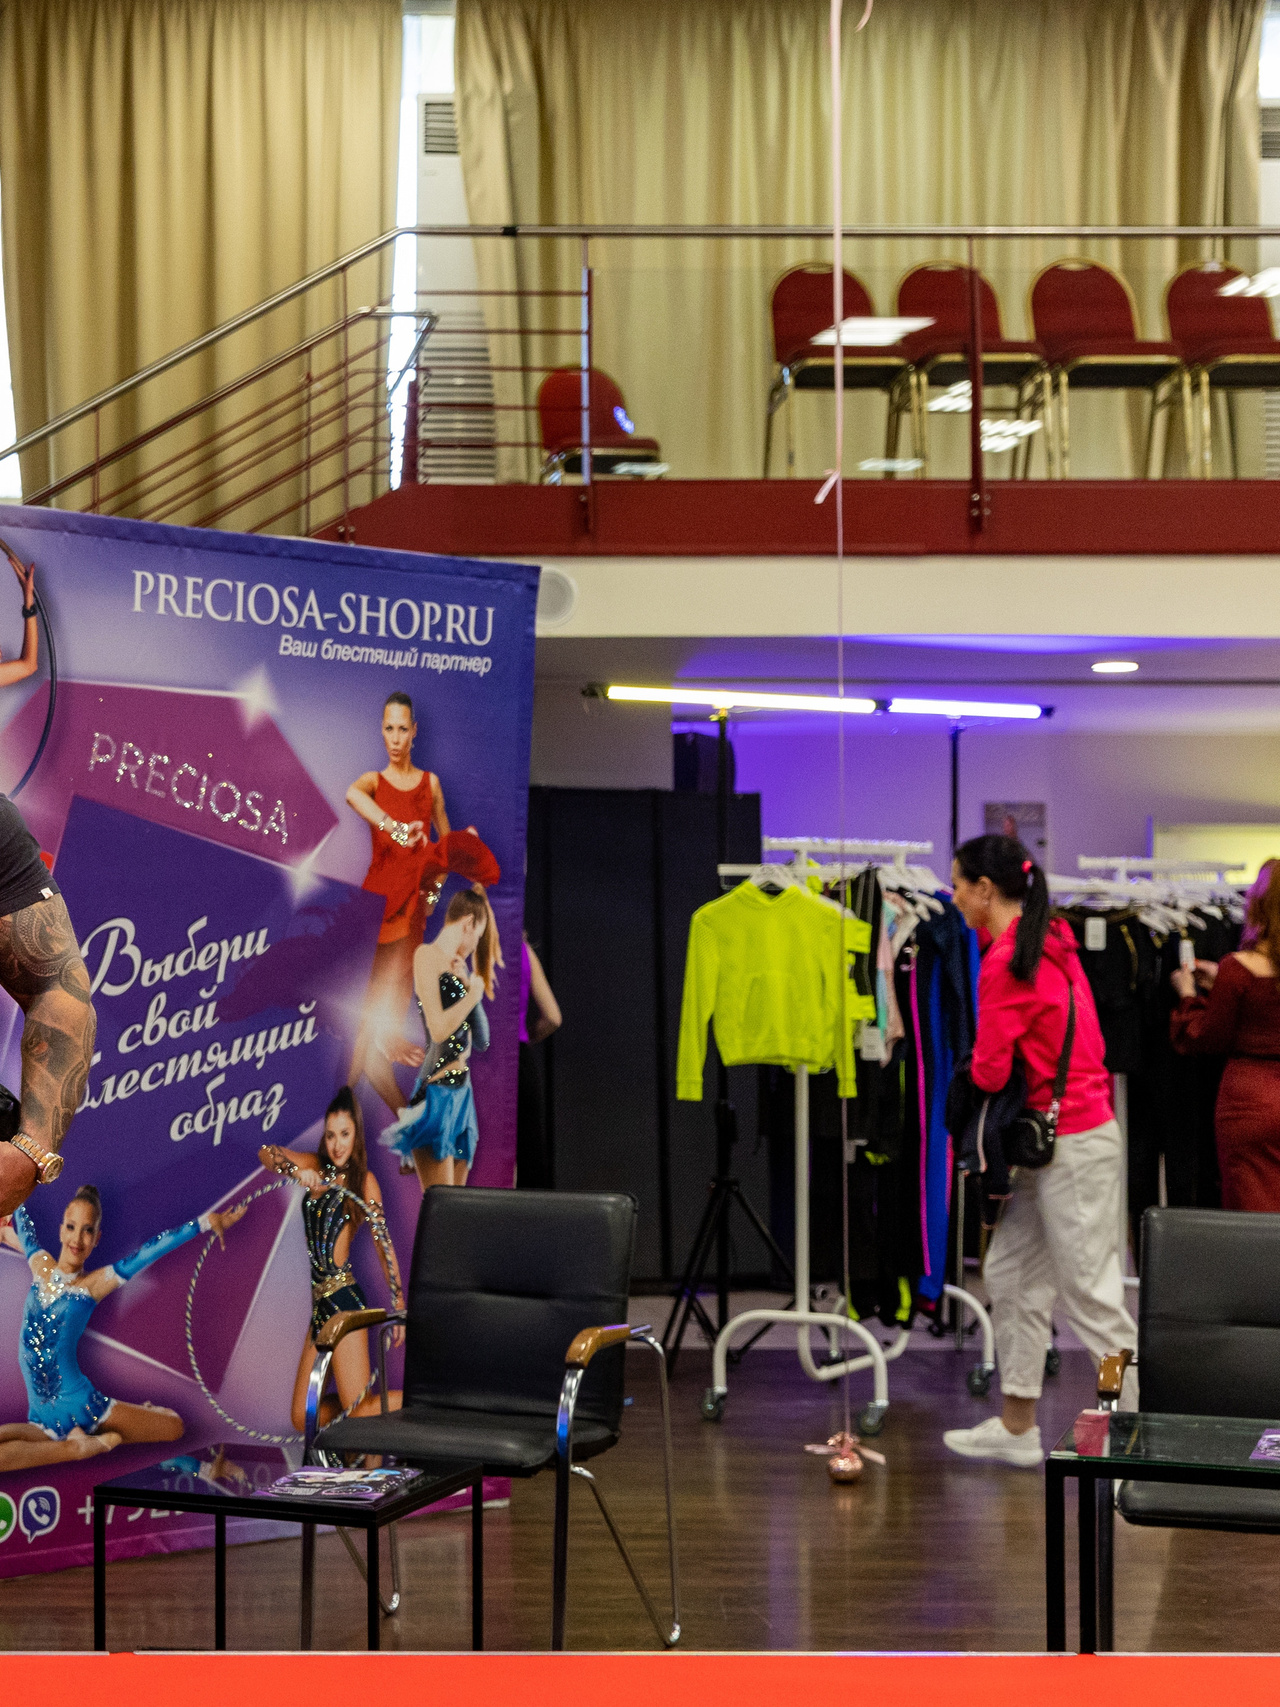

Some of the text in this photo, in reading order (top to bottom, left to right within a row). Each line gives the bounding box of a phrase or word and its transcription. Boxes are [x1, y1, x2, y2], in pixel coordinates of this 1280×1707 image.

[131, 569, 495, 647] PRECIOSA-SHOP.RU
[278, 634, 493, 677] Ваш блестящий партнер
[87, 731, 289, 845] PRECIOSA
[80, 915, 271, 997] Выбери
[117, 984, 220, 1054] свой
[169, 1072, 288, 1147] образ
